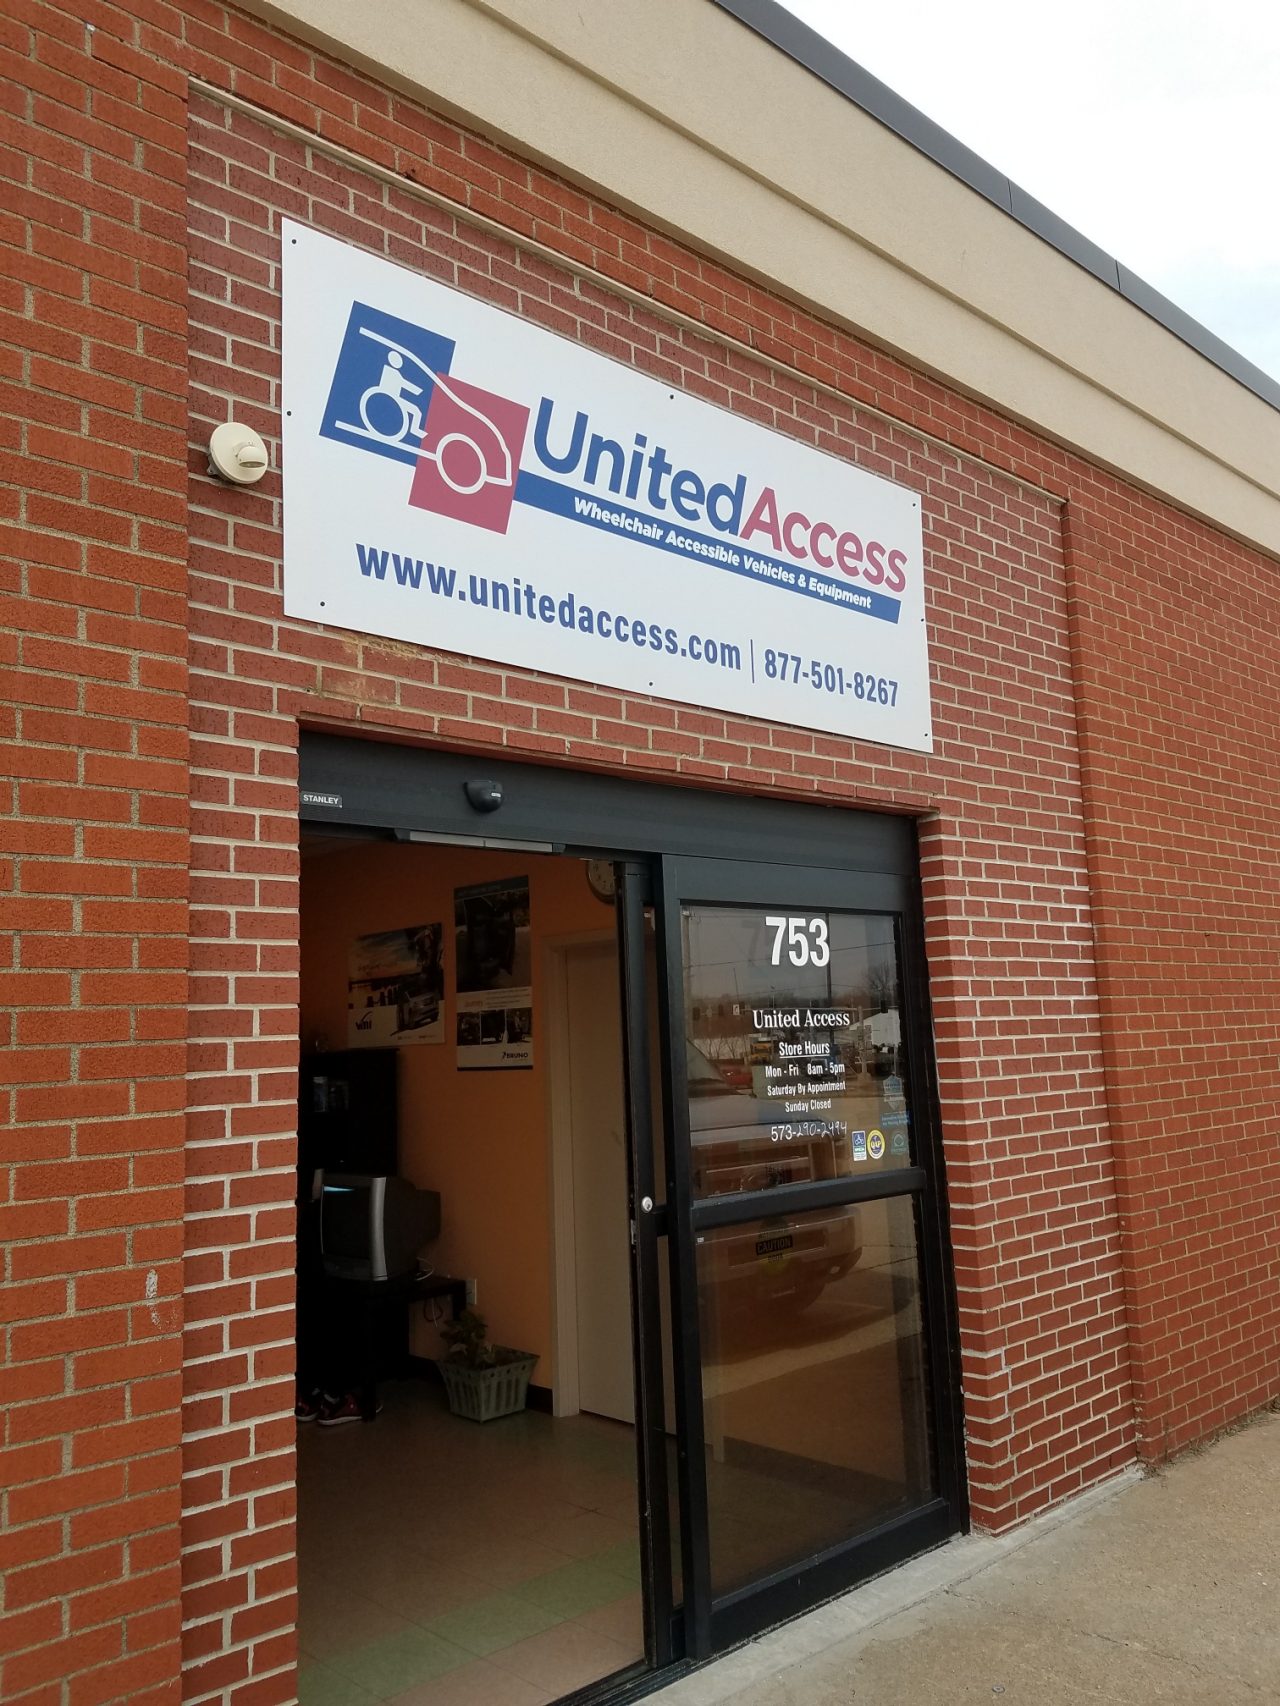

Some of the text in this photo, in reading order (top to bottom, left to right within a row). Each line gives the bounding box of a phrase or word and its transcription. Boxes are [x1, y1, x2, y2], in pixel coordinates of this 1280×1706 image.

[573, 496, 872, 609] Wheelchair Accessible Vehicles & Equipment
[355, 541, 899, 708] www.unitedaccess.com 877-501-8267
[303, 794, 339, 805] STANLEY
[765, 916, 830, 967] 753
[753, 1009, 850, 1028] United Access
[779, 1040, 830, 1056] Store Hours
[765, 1065, 782, 1078] Mon
[789, 1063, 799, 1077] Fri
[807, 1063, 824, 1075] 8am
[829, 1062, 845, 1076] 5pm
[767, 1081, 846, 1096] Saturday By Appointment
[785, 1098, 832, 1113] Sunday Closed
[757, 1237, 791, 1253] CAUTION
